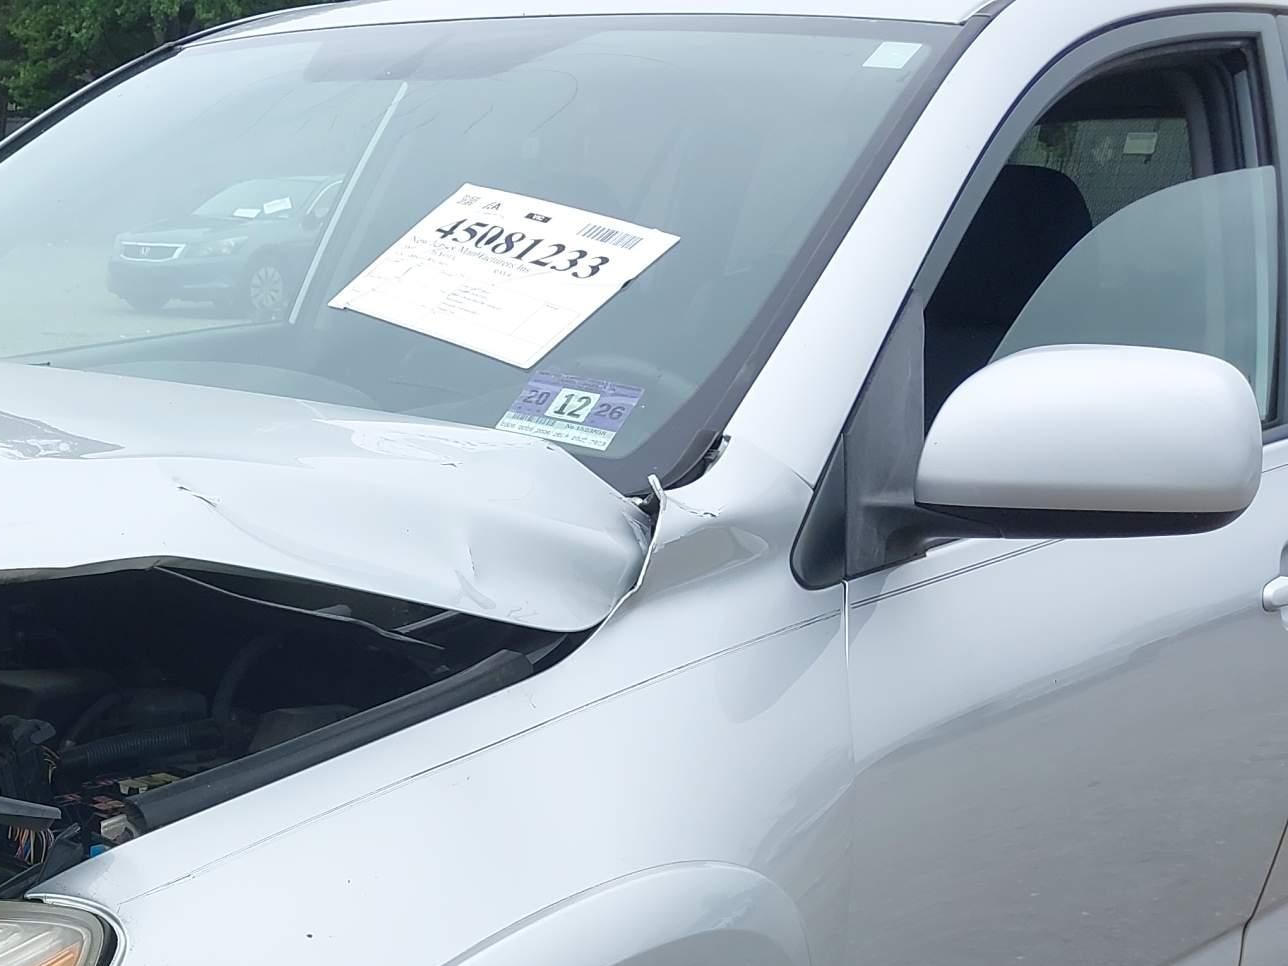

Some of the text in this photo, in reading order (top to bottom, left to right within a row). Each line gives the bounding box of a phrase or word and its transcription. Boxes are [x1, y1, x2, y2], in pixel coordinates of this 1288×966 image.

[435, 218, 610, 279] 45081233
[522, 389, 626, 420] 20 12 26
